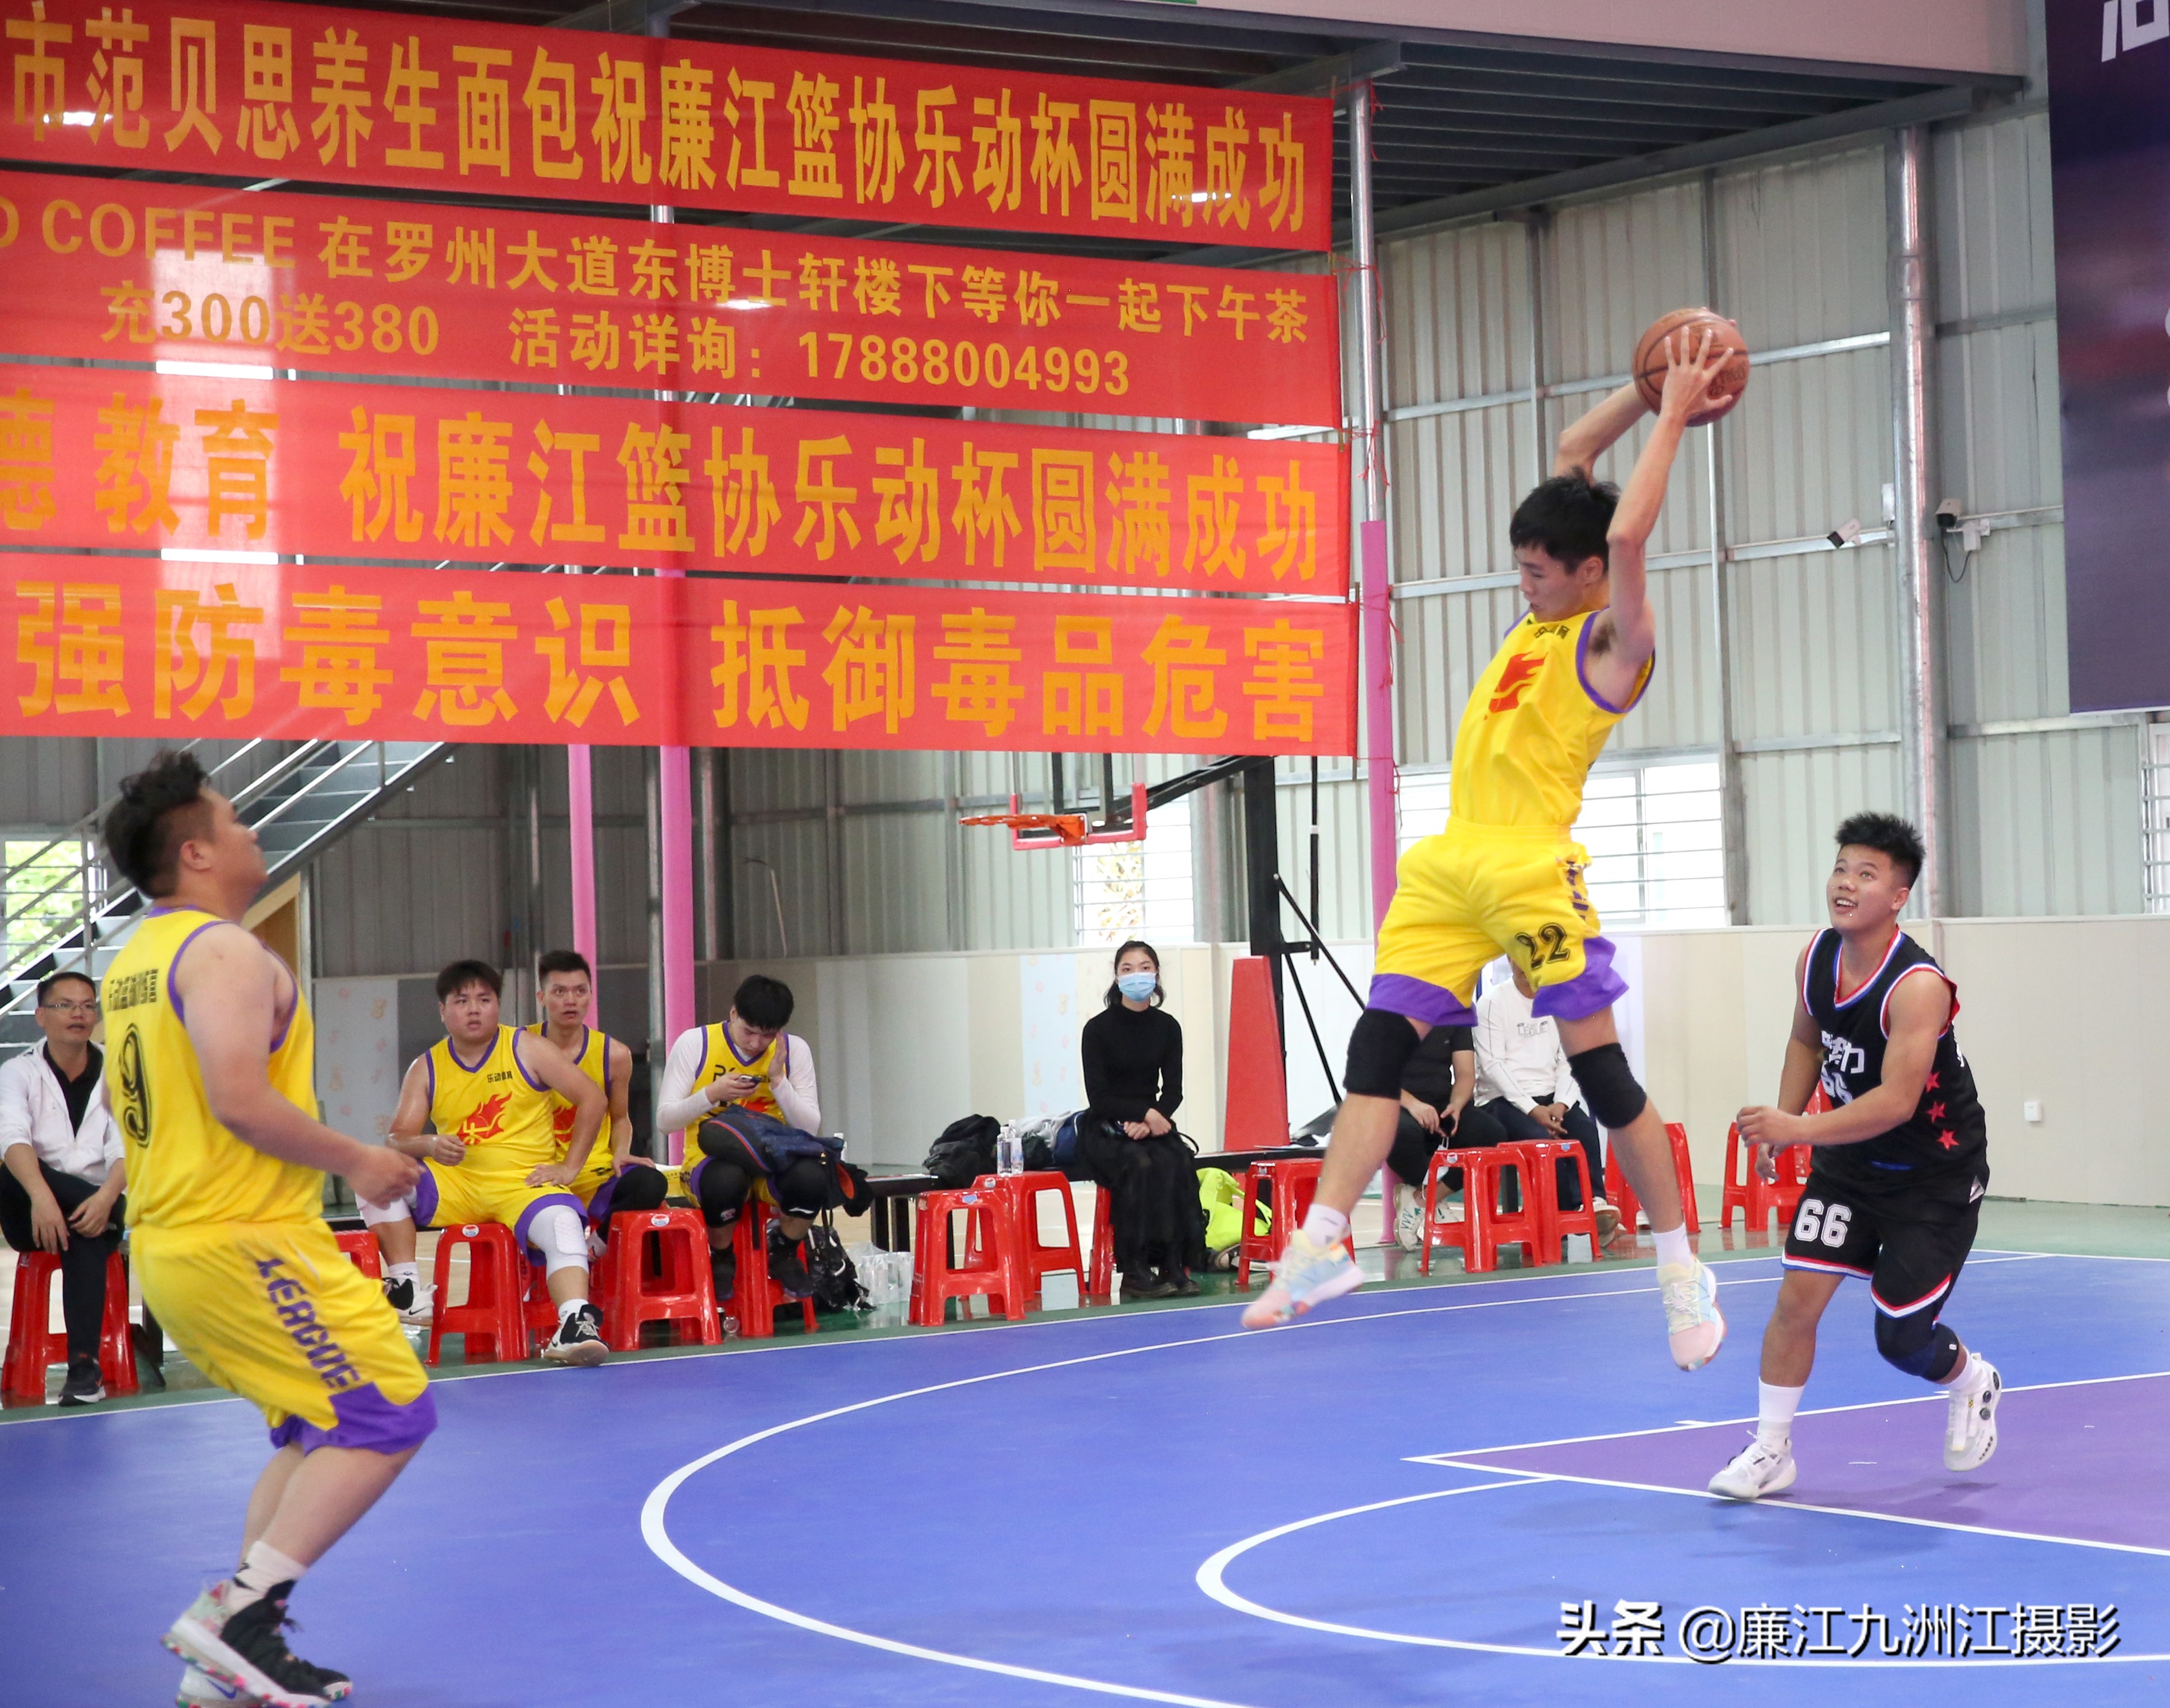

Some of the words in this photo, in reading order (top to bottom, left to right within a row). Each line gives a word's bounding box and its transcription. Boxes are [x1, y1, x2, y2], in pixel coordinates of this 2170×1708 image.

[5, 0, 1305, 232] 市范贝思养生面包祝廉江篮协乐动杯圆满成功
[42, 199, 295, 269] COFFEE
[319, 215, 1309, 344] 在罗州大道东博士轩楼下等你一起下午茶
[100, 281, 439, 356] 充300送380
[339, 405, 1317, 581] 祝廉江篮协乐动杯圆满成功
[16, 580, 640, 728] 强防毒意识
[710, 599, 1324, 743] 抵御毒品危害
[120, 1023, 152, 1149] 9
[1794, 1198, 1852, 1249] 66
